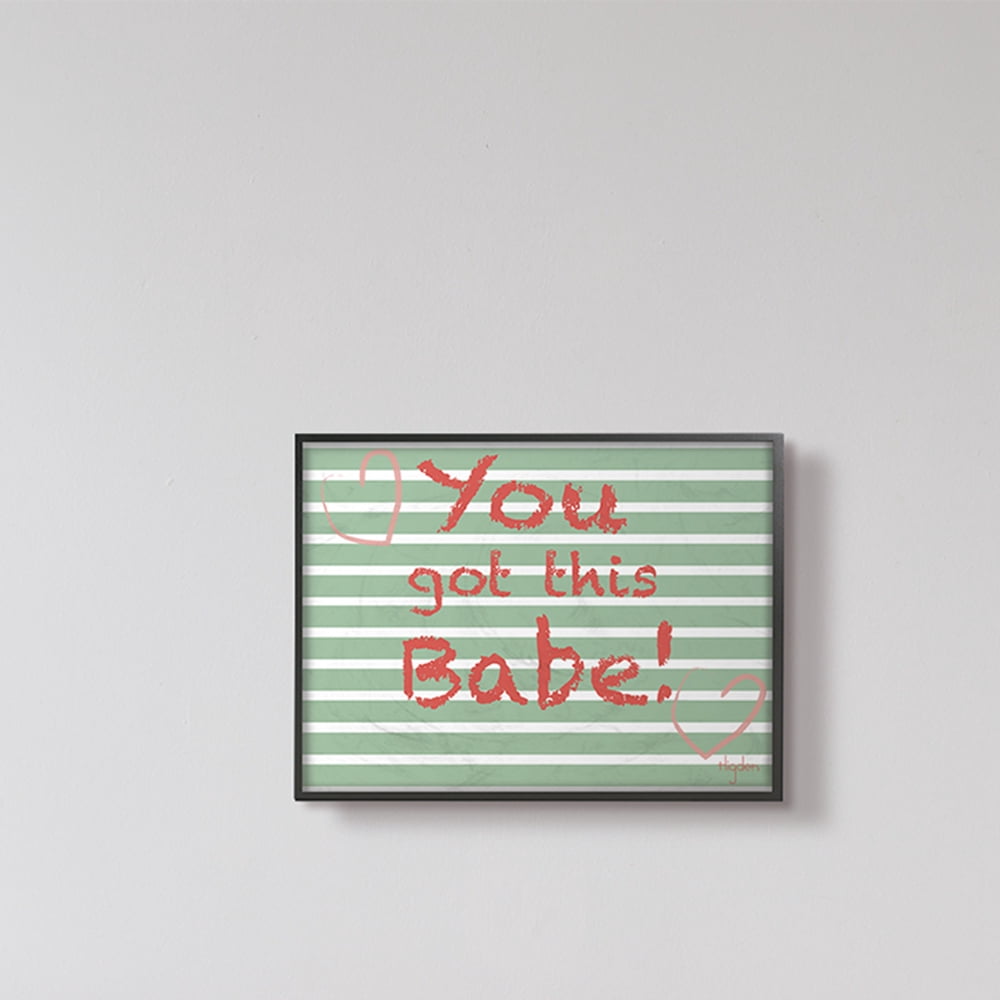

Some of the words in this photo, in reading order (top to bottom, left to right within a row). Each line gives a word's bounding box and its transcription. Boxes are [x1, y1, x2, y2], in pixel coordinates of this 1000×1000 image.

[418, 455, 626, 534] You
[409, 551, 510, 616] got
[546, 551, 656, 597] this
[402, 614, 672, 709] Babe!
